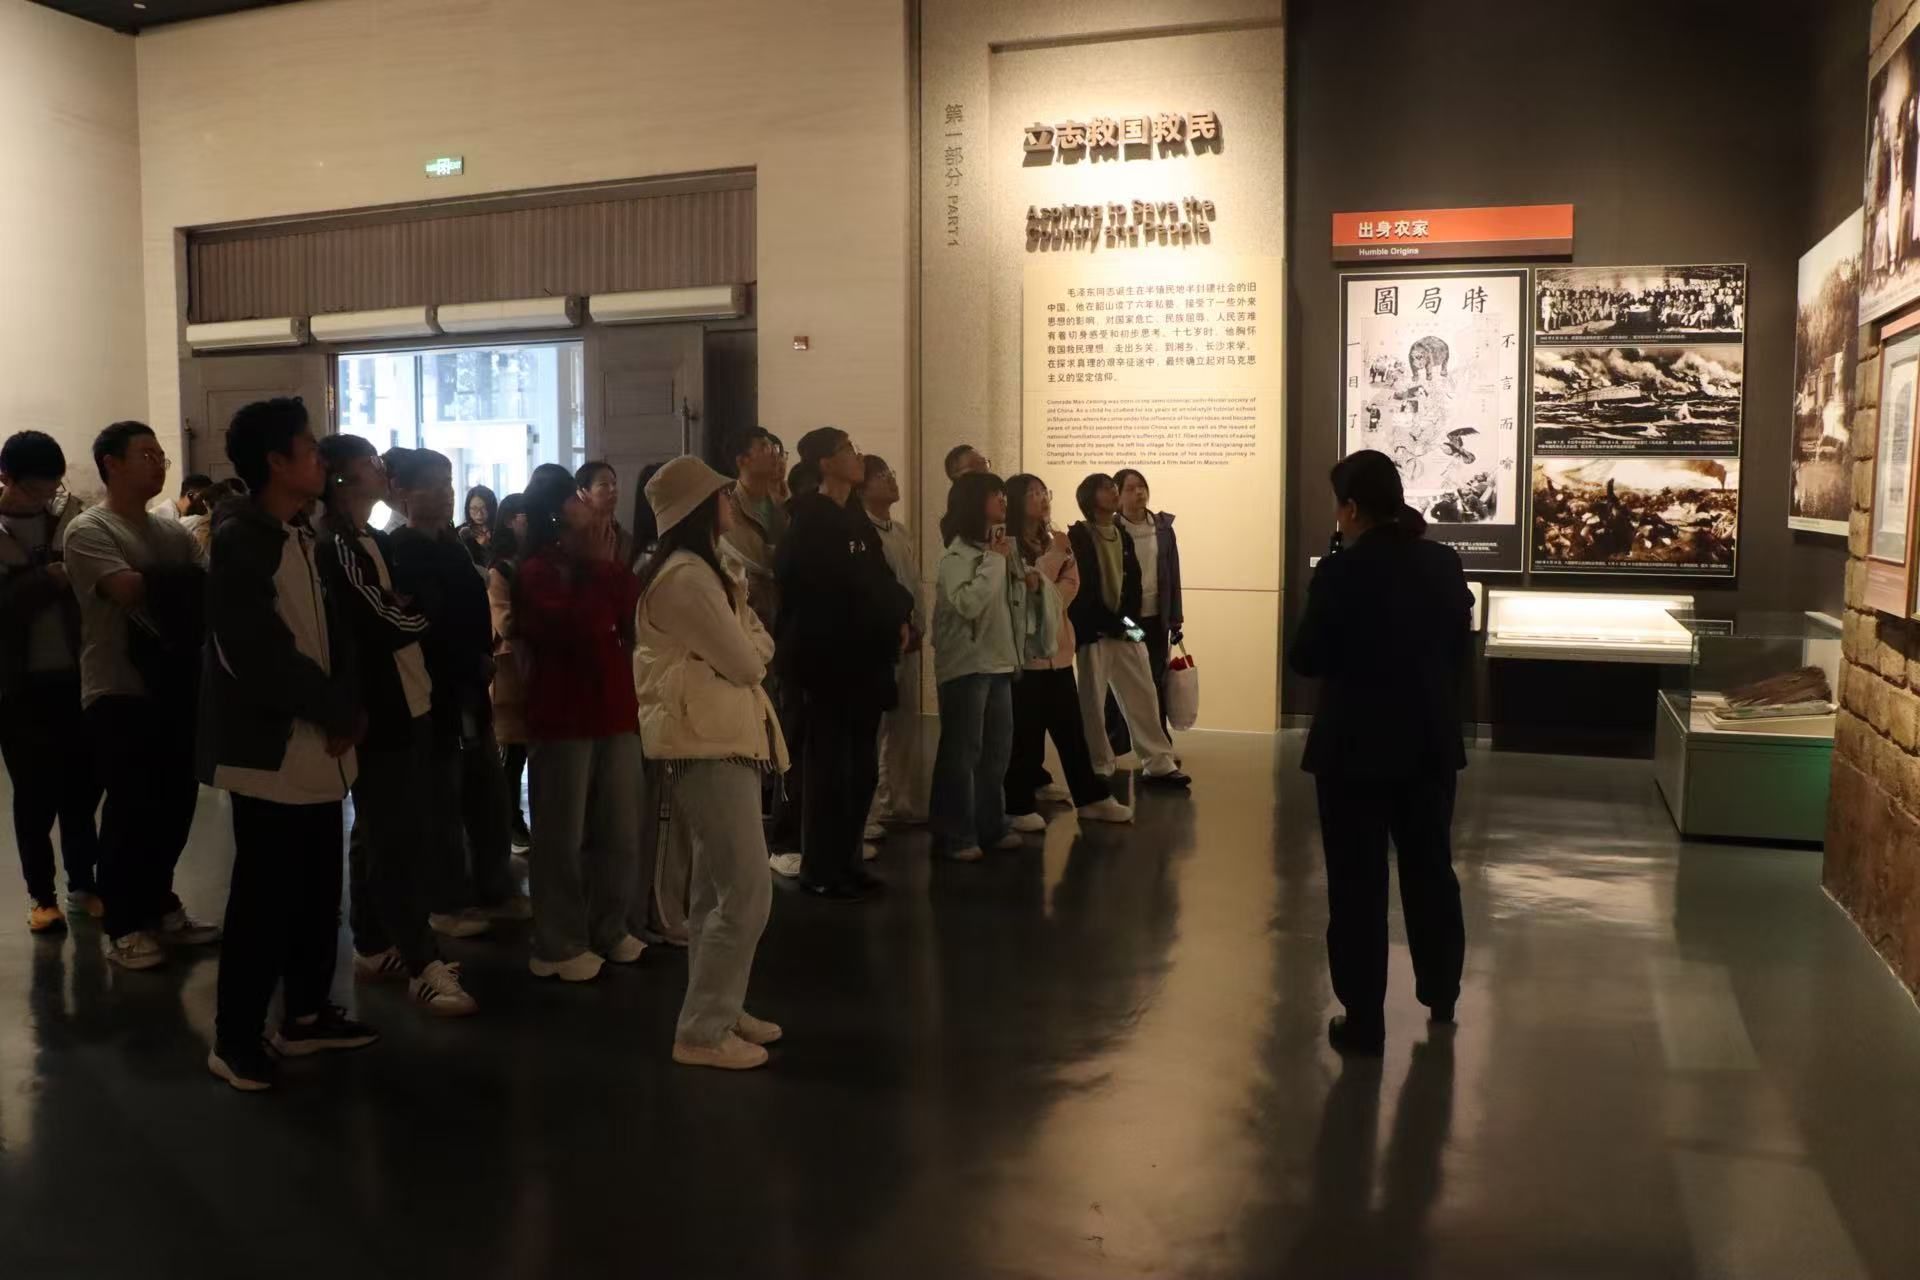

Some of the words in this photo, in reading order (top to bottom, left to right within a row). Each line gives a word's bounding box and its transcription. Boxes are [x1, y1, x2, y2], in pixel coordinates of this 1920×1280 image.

[945, 103, 963, 187] 第一部分
[1024, 111, 1219, 153] 立志救国救民
[947, 195, 959, 235] PART
[1026, 203, 1103, 222] Aspiring
[1107, 200, 1127, 220] to
[1132, 199, 1179, 220] Save
[1182, 195, 1216, 217] the
[1026, 225, 1100, 247] Country
[1105, 224, 1139, 245] and
[1143, 221, 1212, 244] People
[1359, 220, 1429, 239] 出身农家
[1359, 248, 1388, 256] Humble
[1390, 247, 1419, 256] Origins
